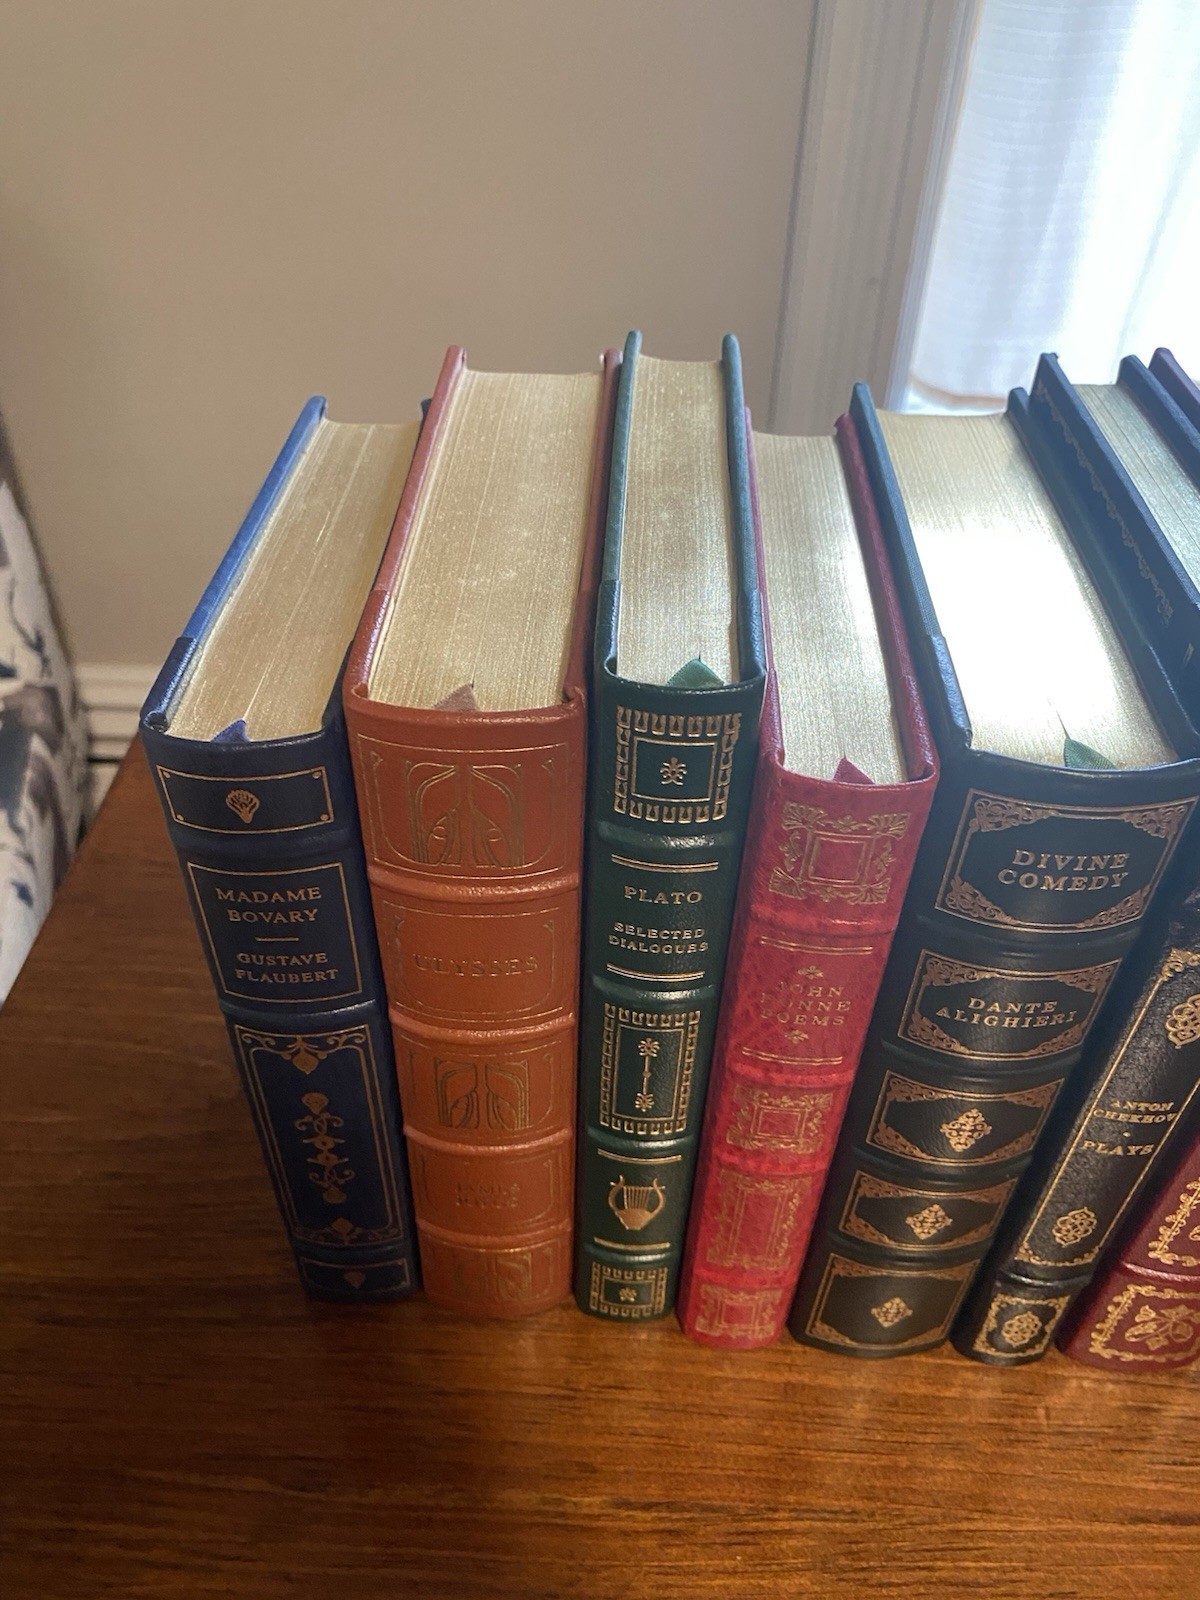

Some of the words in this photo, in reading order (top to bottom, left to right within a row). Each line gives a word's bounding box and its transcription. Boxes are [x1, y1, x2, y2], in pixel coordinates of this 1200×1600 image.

[1012, 850, 1130, 871] DIVINE
[997, 868, 1129, 891] COMEDY
[215, 886, 322, 905] MADAME
[624, 885, 703, 905] PLATO
[227, 908, 319, 924] BOVARY
[614, 921, 705, 940] SELECTED
[608, 934, 709, 955] DIALOGUES
[236, 952, 328, 966] GUSTAVE
[412, 953, 538, 977] ULYSSES
[235, 968, 338, 984] FLAUBERT
[968, 997, 1058, 1014] DANTE
[761, 1008, 845, 1027] POEMS
[936, 1007, 1078, 1028] ALIGHIERI
[1111, 1100, 1174, 1112] ANTON
[1093, 1109, 1178, 1124] CHEKHOV
[1082, 1140, 1155, 1156] PLAYS
